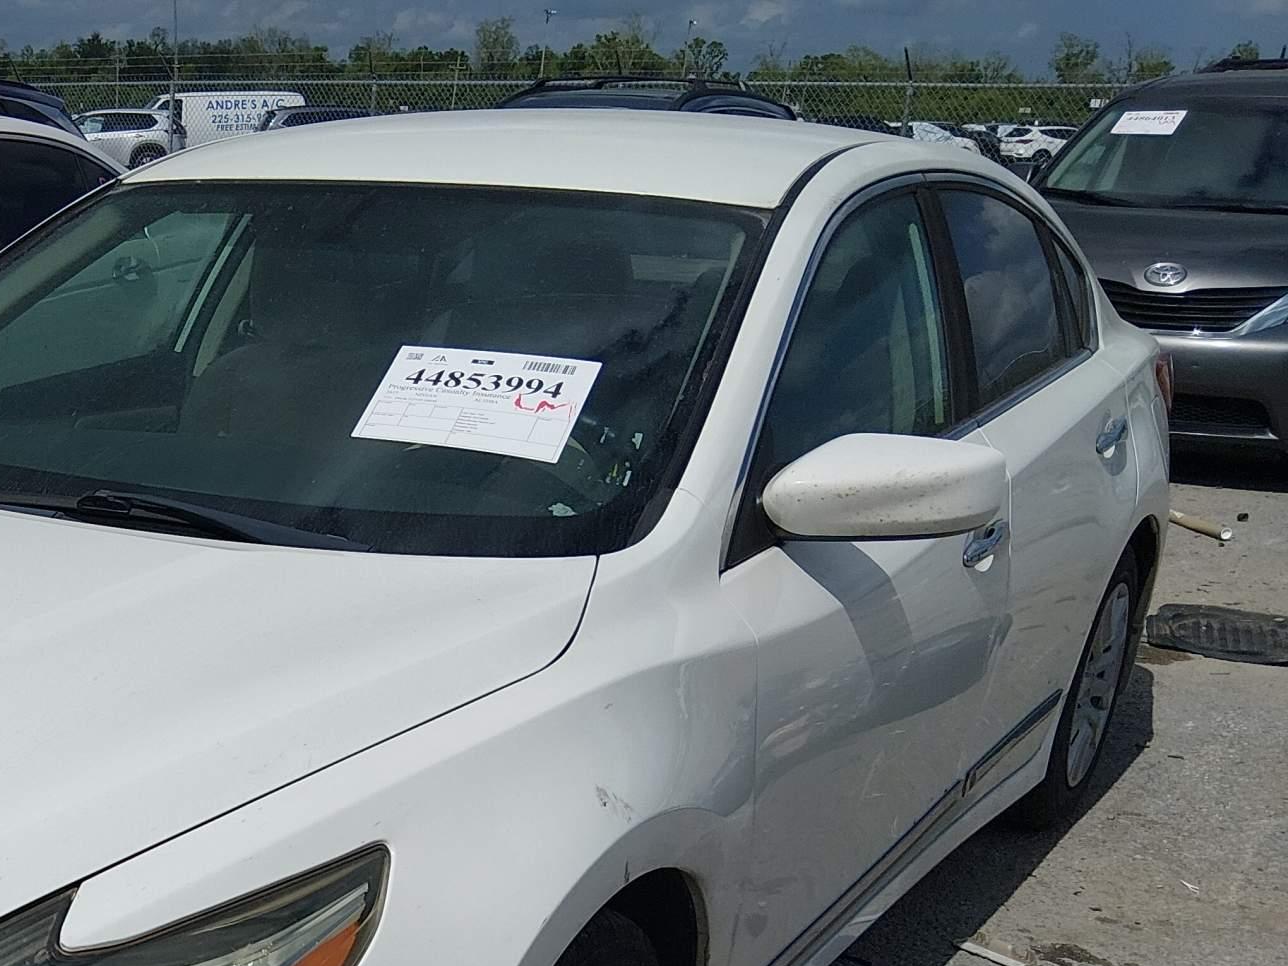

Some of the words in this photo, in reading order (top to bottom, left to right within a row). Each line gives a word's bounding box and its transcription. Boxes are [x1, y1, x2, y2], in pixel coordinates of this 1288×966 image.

[206, 99, 257, 110] ANDRE'S
[388, 383, 434, 393] Progressive
[435, 387, 470, 397] Casualty
[472, 390, 512, 400] Insurance
[405, 368, 564, 398] 44853994
